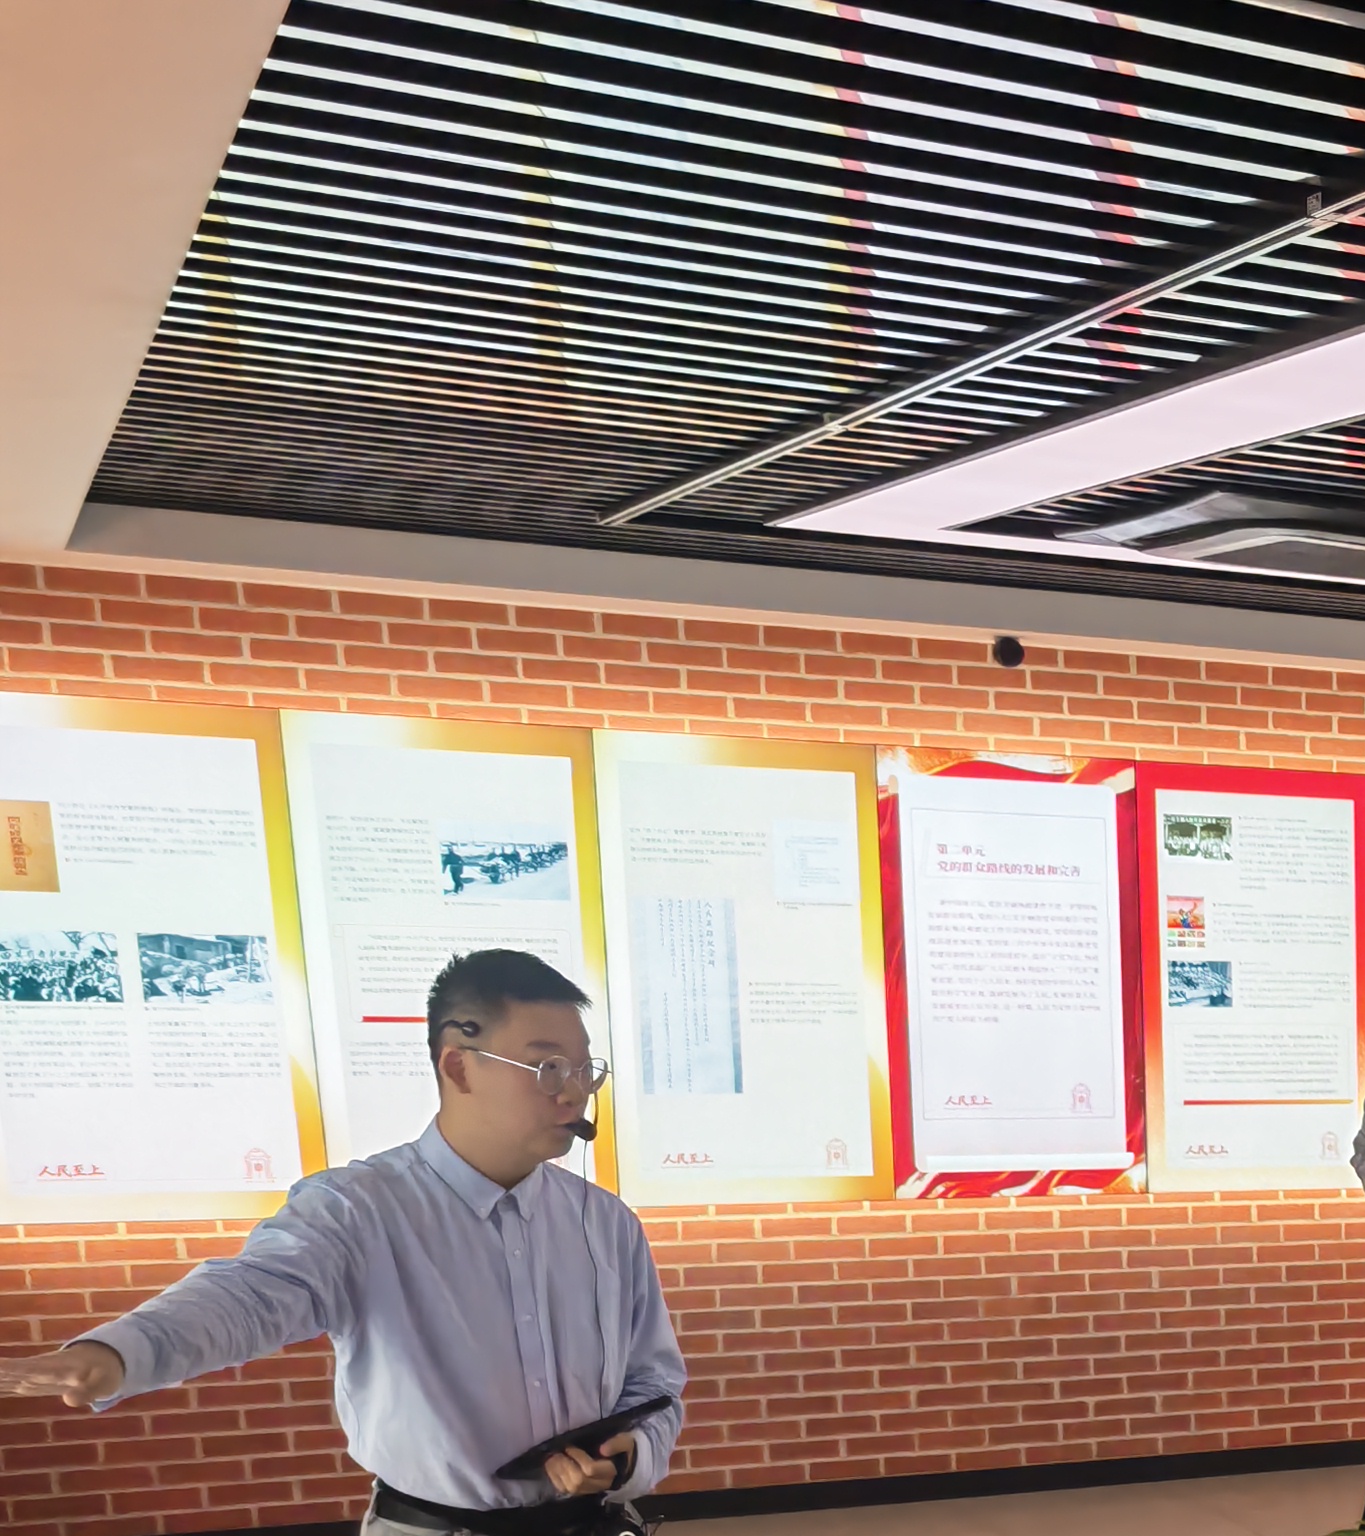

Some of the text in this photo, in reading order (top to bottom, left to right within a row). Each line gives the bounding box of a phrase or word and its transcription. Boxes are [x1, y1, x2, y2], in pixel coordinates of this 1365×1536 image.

[945, 1095, 992, 1106] 人民至上
[663, 1153, 714, 1165] 人民至上
[39, 1164, 105, 1178] 人民至上
